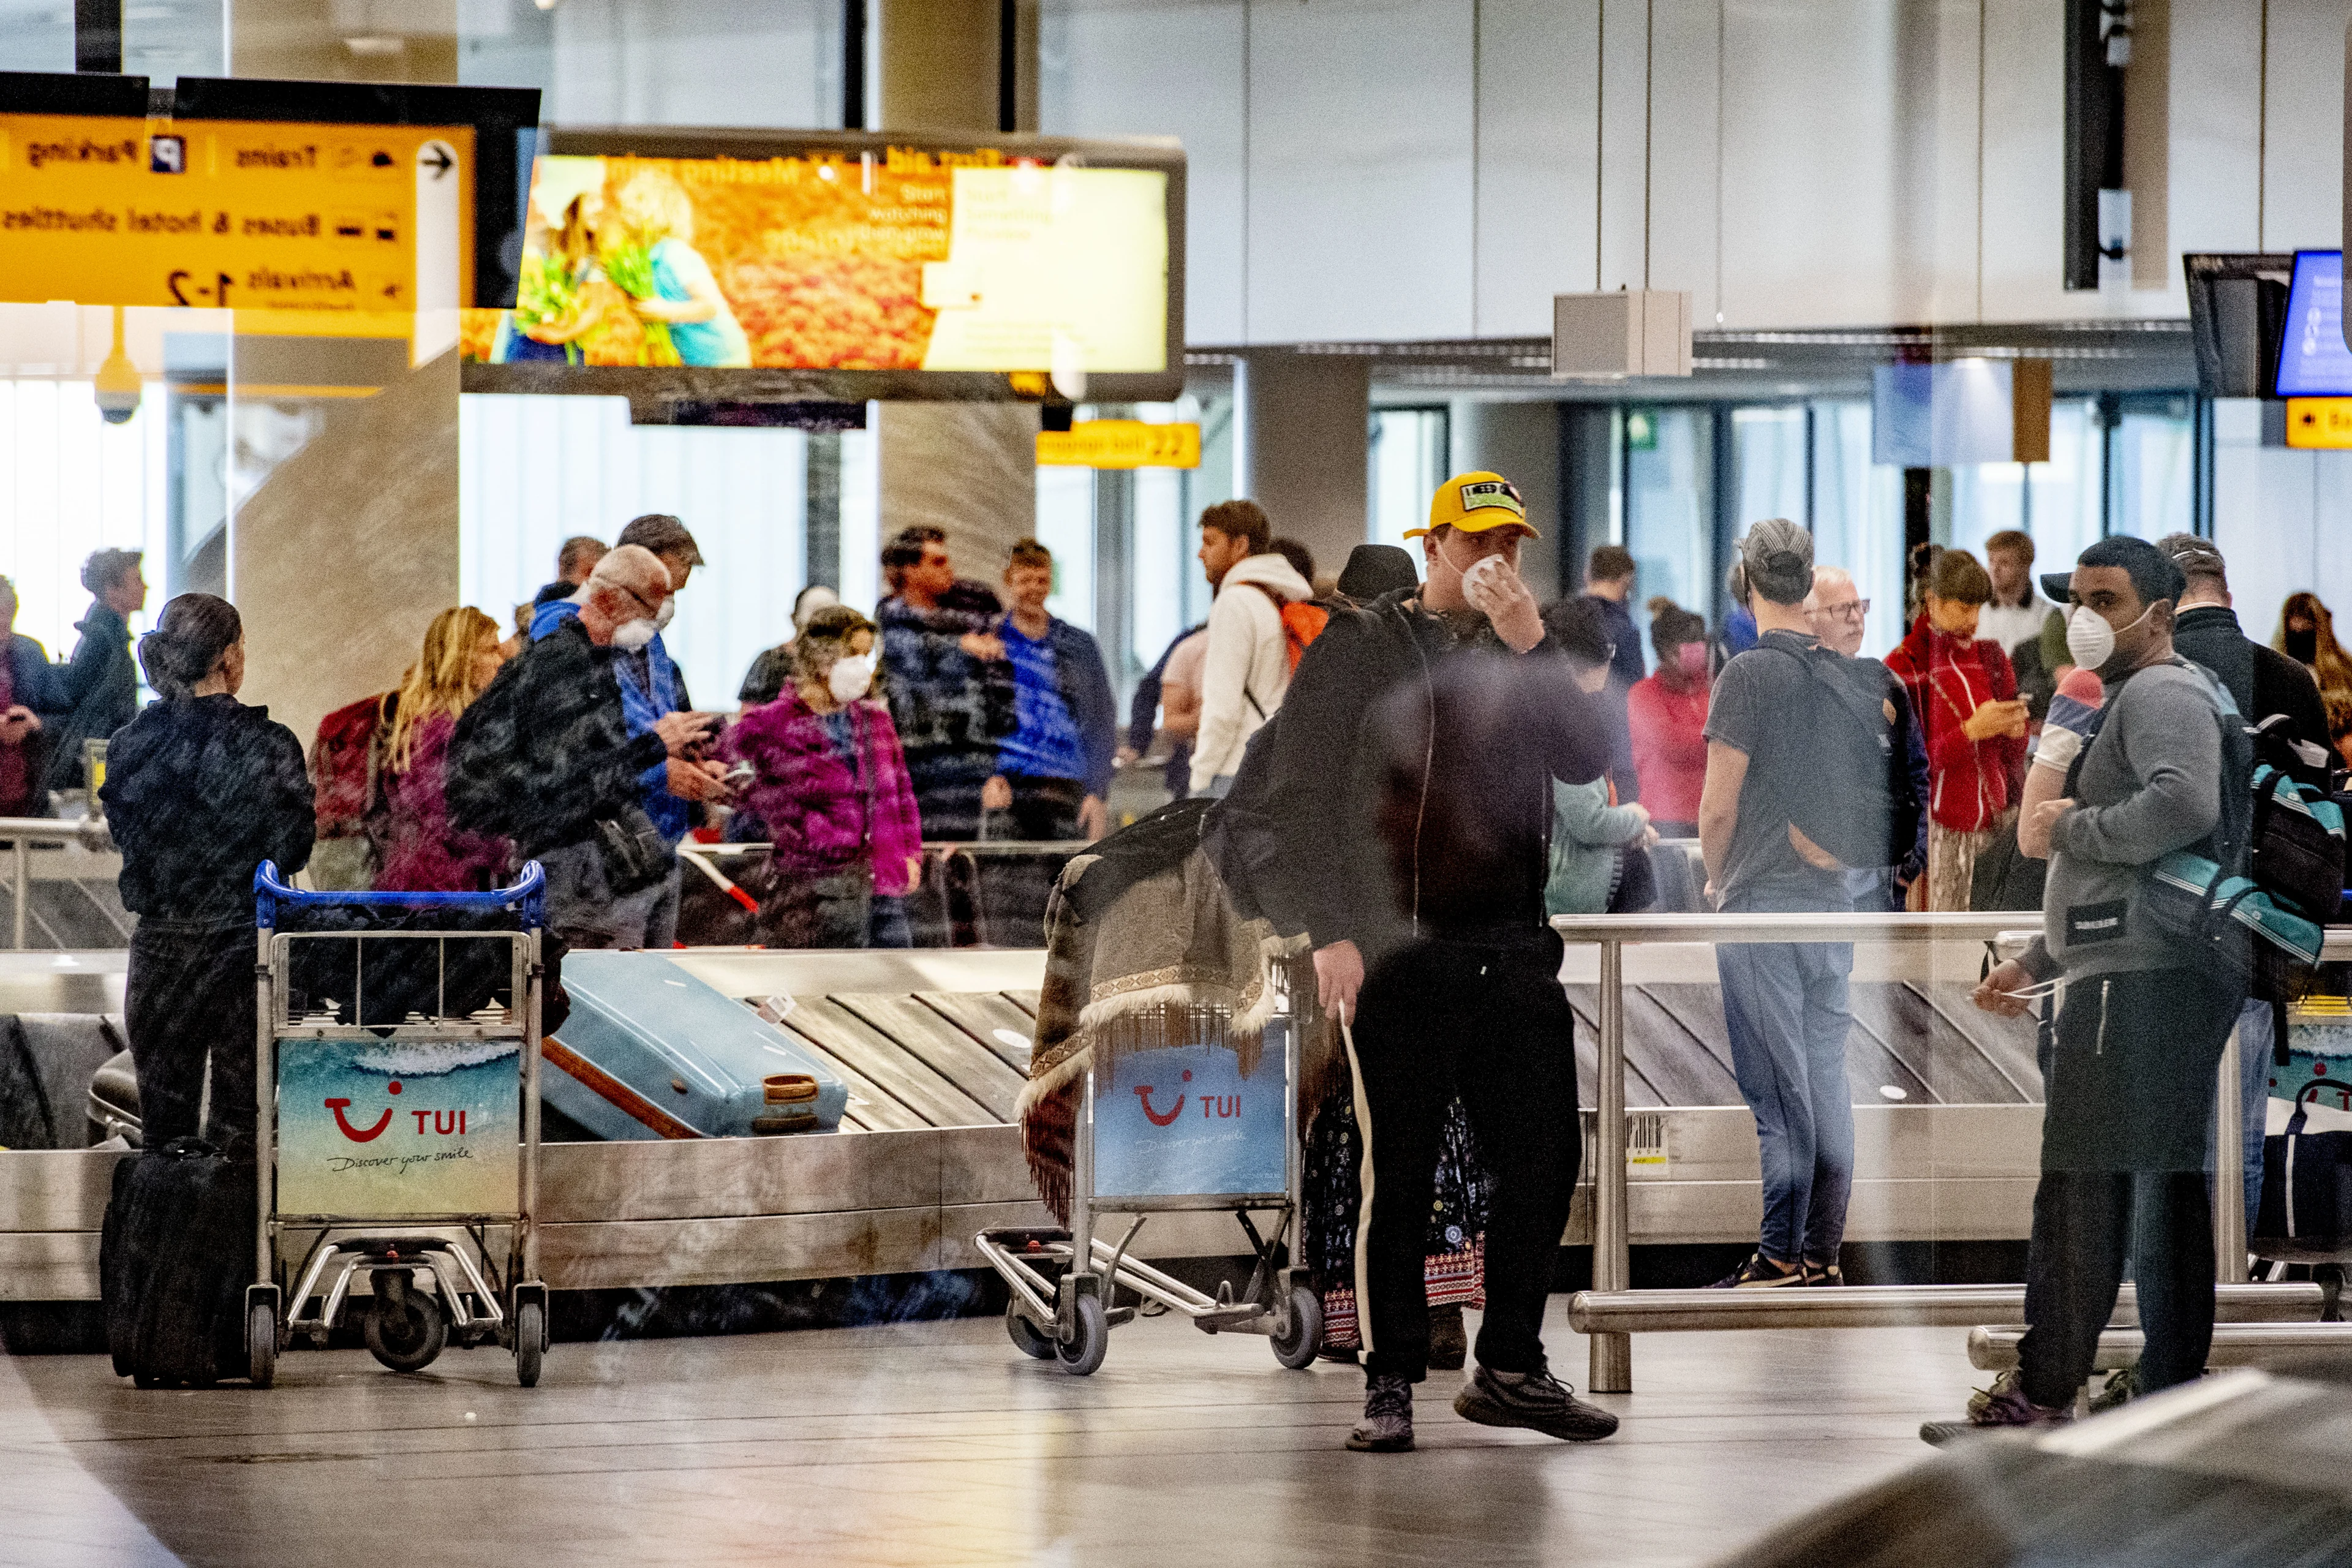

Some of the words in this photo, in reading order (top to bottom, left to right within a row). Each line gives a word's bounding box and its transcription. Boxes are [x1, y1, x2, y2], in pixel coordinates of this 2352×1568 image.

[1152, 429, 1186, 458] 22
[1199, 1095, 1242, 1118] TUI
[410, 1110, 467, 1135] TUI
[326, 1156, 399, 1172] Discover
[399, 1153, 432, 1175] your
[433, 1147, 475, 1162] smile
